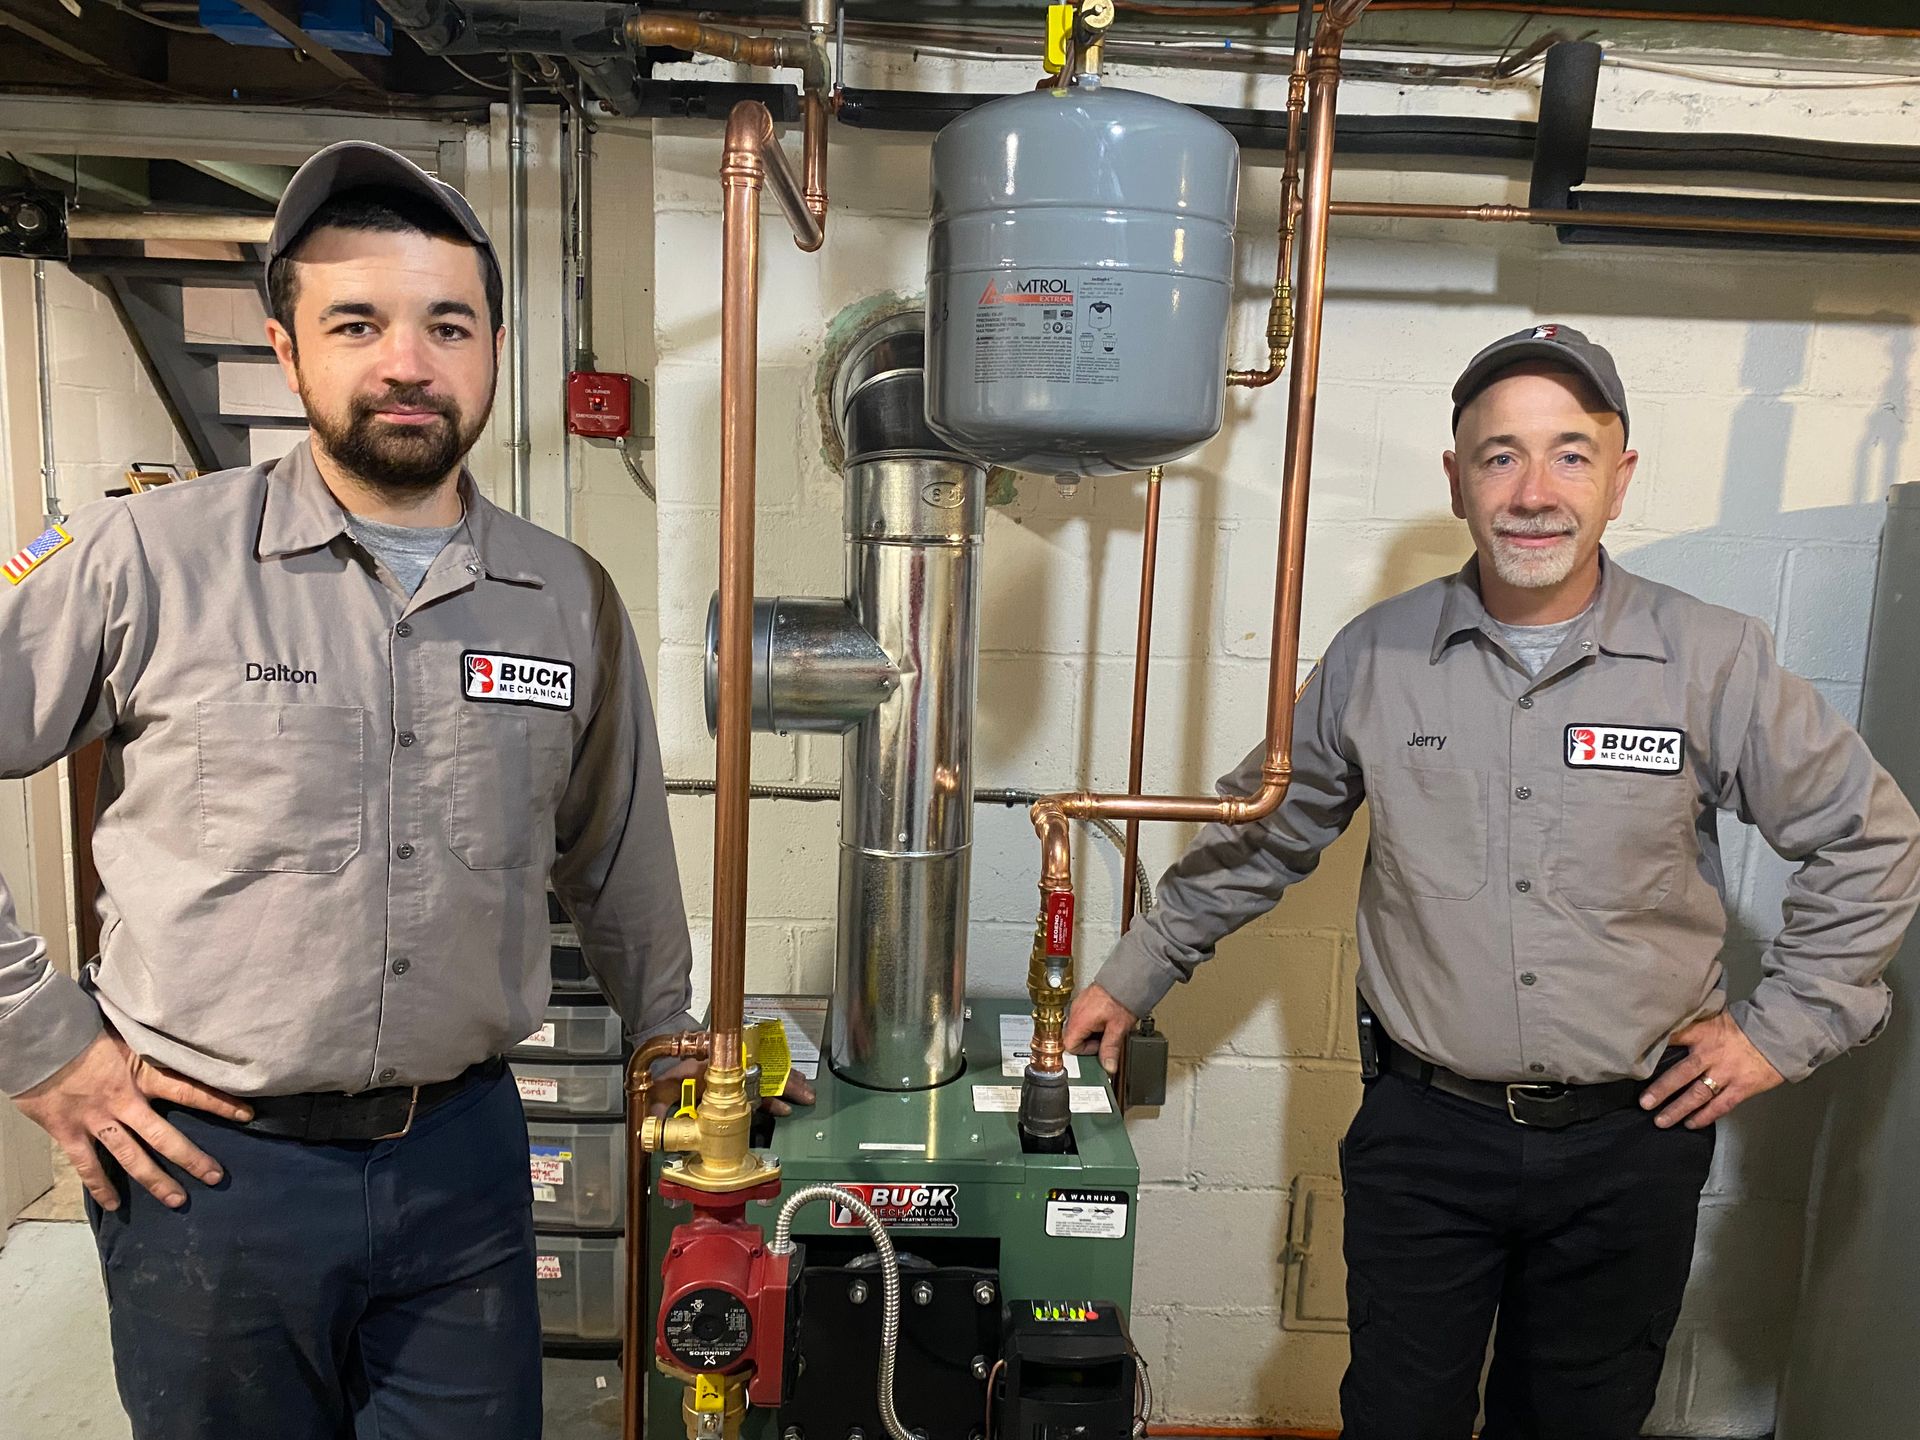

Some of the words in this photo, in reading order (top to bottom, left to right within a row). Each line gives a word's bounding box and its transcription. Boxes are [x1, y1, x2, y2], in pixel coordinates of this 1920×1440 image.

[245, 662, 317, 684] Dalton
[500, 663, 569, 689] BUCK
[499, 683, 569, 701] MECHANICAL
[1407, 732, 1447, 750] Jerry
[1601, 733, 1678, 754] BUCK
[1600, 752, 1678, 765] MECHANICAL
[870, 1188, 952, 1207] BUCK
[1070, 1193, 1116, 1202] WARNING
